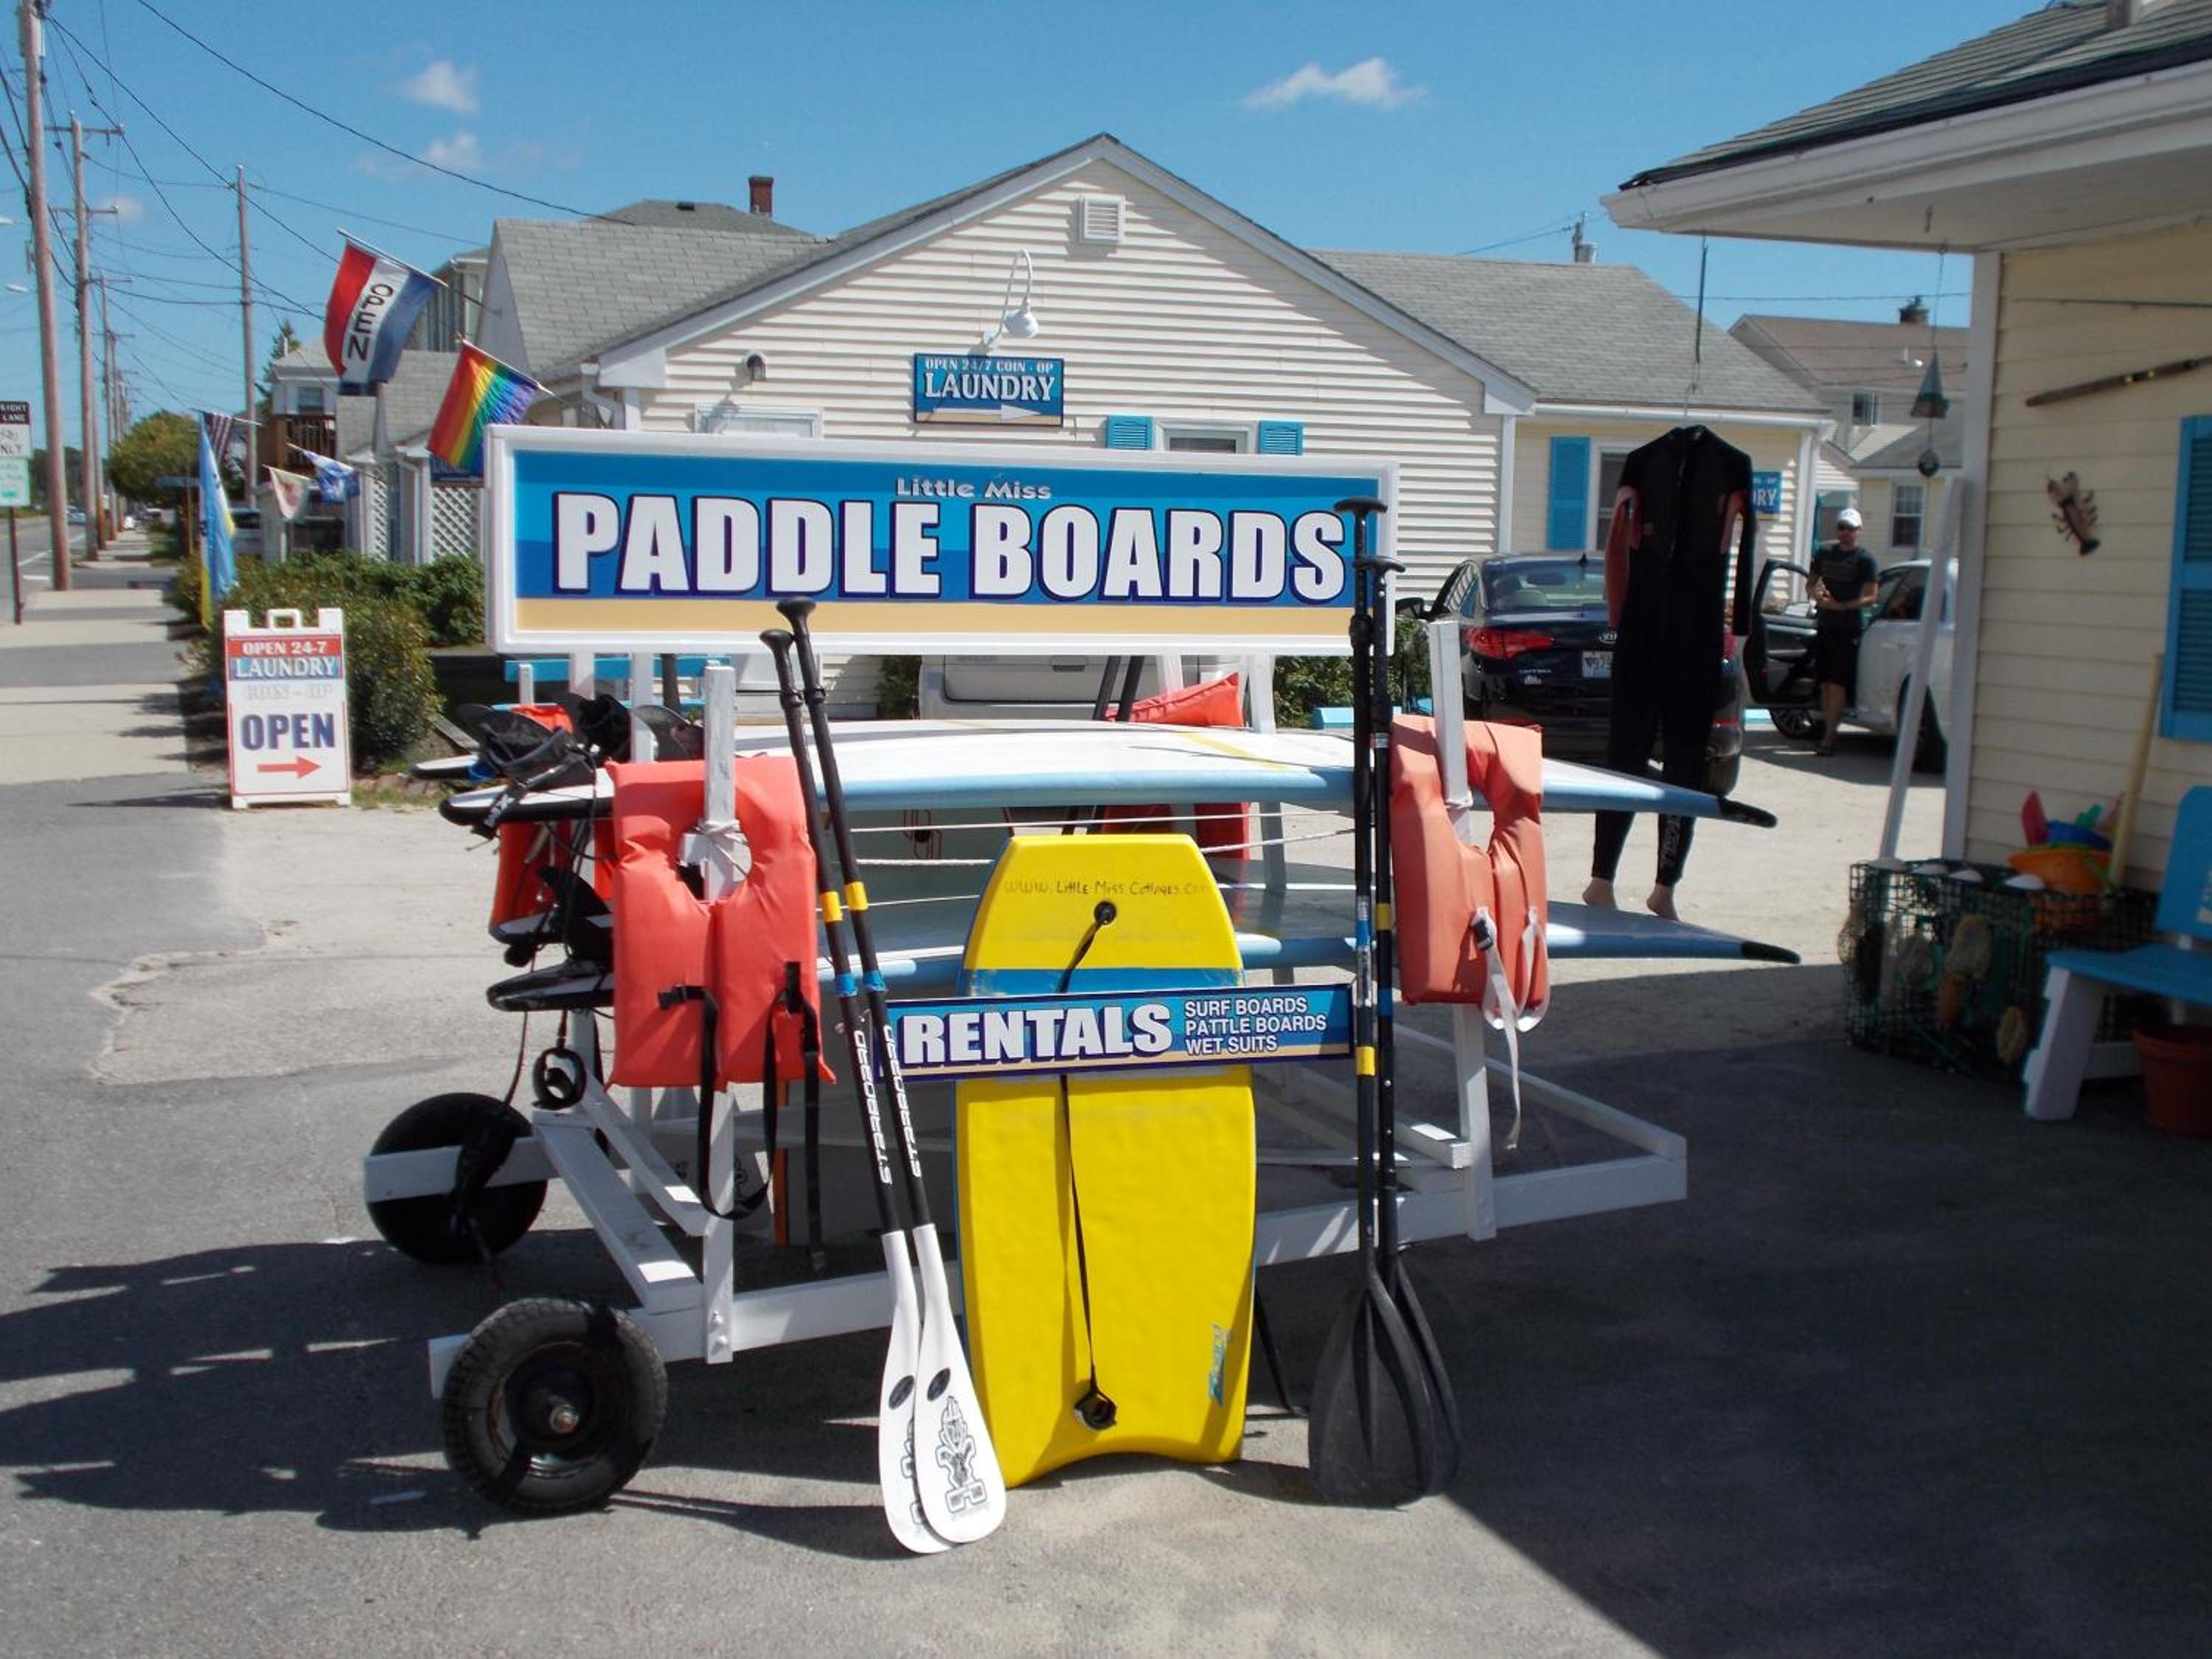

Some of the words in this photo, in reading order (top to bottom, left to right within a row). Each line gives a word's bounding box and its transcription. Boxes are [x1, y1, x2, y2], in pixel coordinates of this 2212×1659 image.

[347, 284, 394, 361] OPEN
[925, 357, 958, 370] OPEN
[961, 359, 991, 371] 24/7
[996, 360, 1026, 372] COIN
[1036, 362, 1054, 373] OP
[925, 372, 1055, 400] LAUNDRY
[897, 478, 975, 498] Little
[984, 481, 1051, 499] Miss
[552, 492, 942, 599] PADDLE
[970, 503, 1346, 605] BOARDS
[242, 641, 287, 655] OPEN
[291, 641, 327, 654] 24-7
[236, 658, 336, 678] LAUNDRY
[241, 713, 335, 751] OPEN
[1185, 1000, 1230, 1018] SURF
[1235, 997, 1307, 1015] BOARDS
[898, 1004, 1174, 1068] RENTALS
[1186, 1018, 1251, 1036] PATTLE
[1256, 1015, 1327, 1033] BOARDS
[1186, 1037, 1223, 1056] WET
[1228, 1035, 1278, 1053] SUITS
